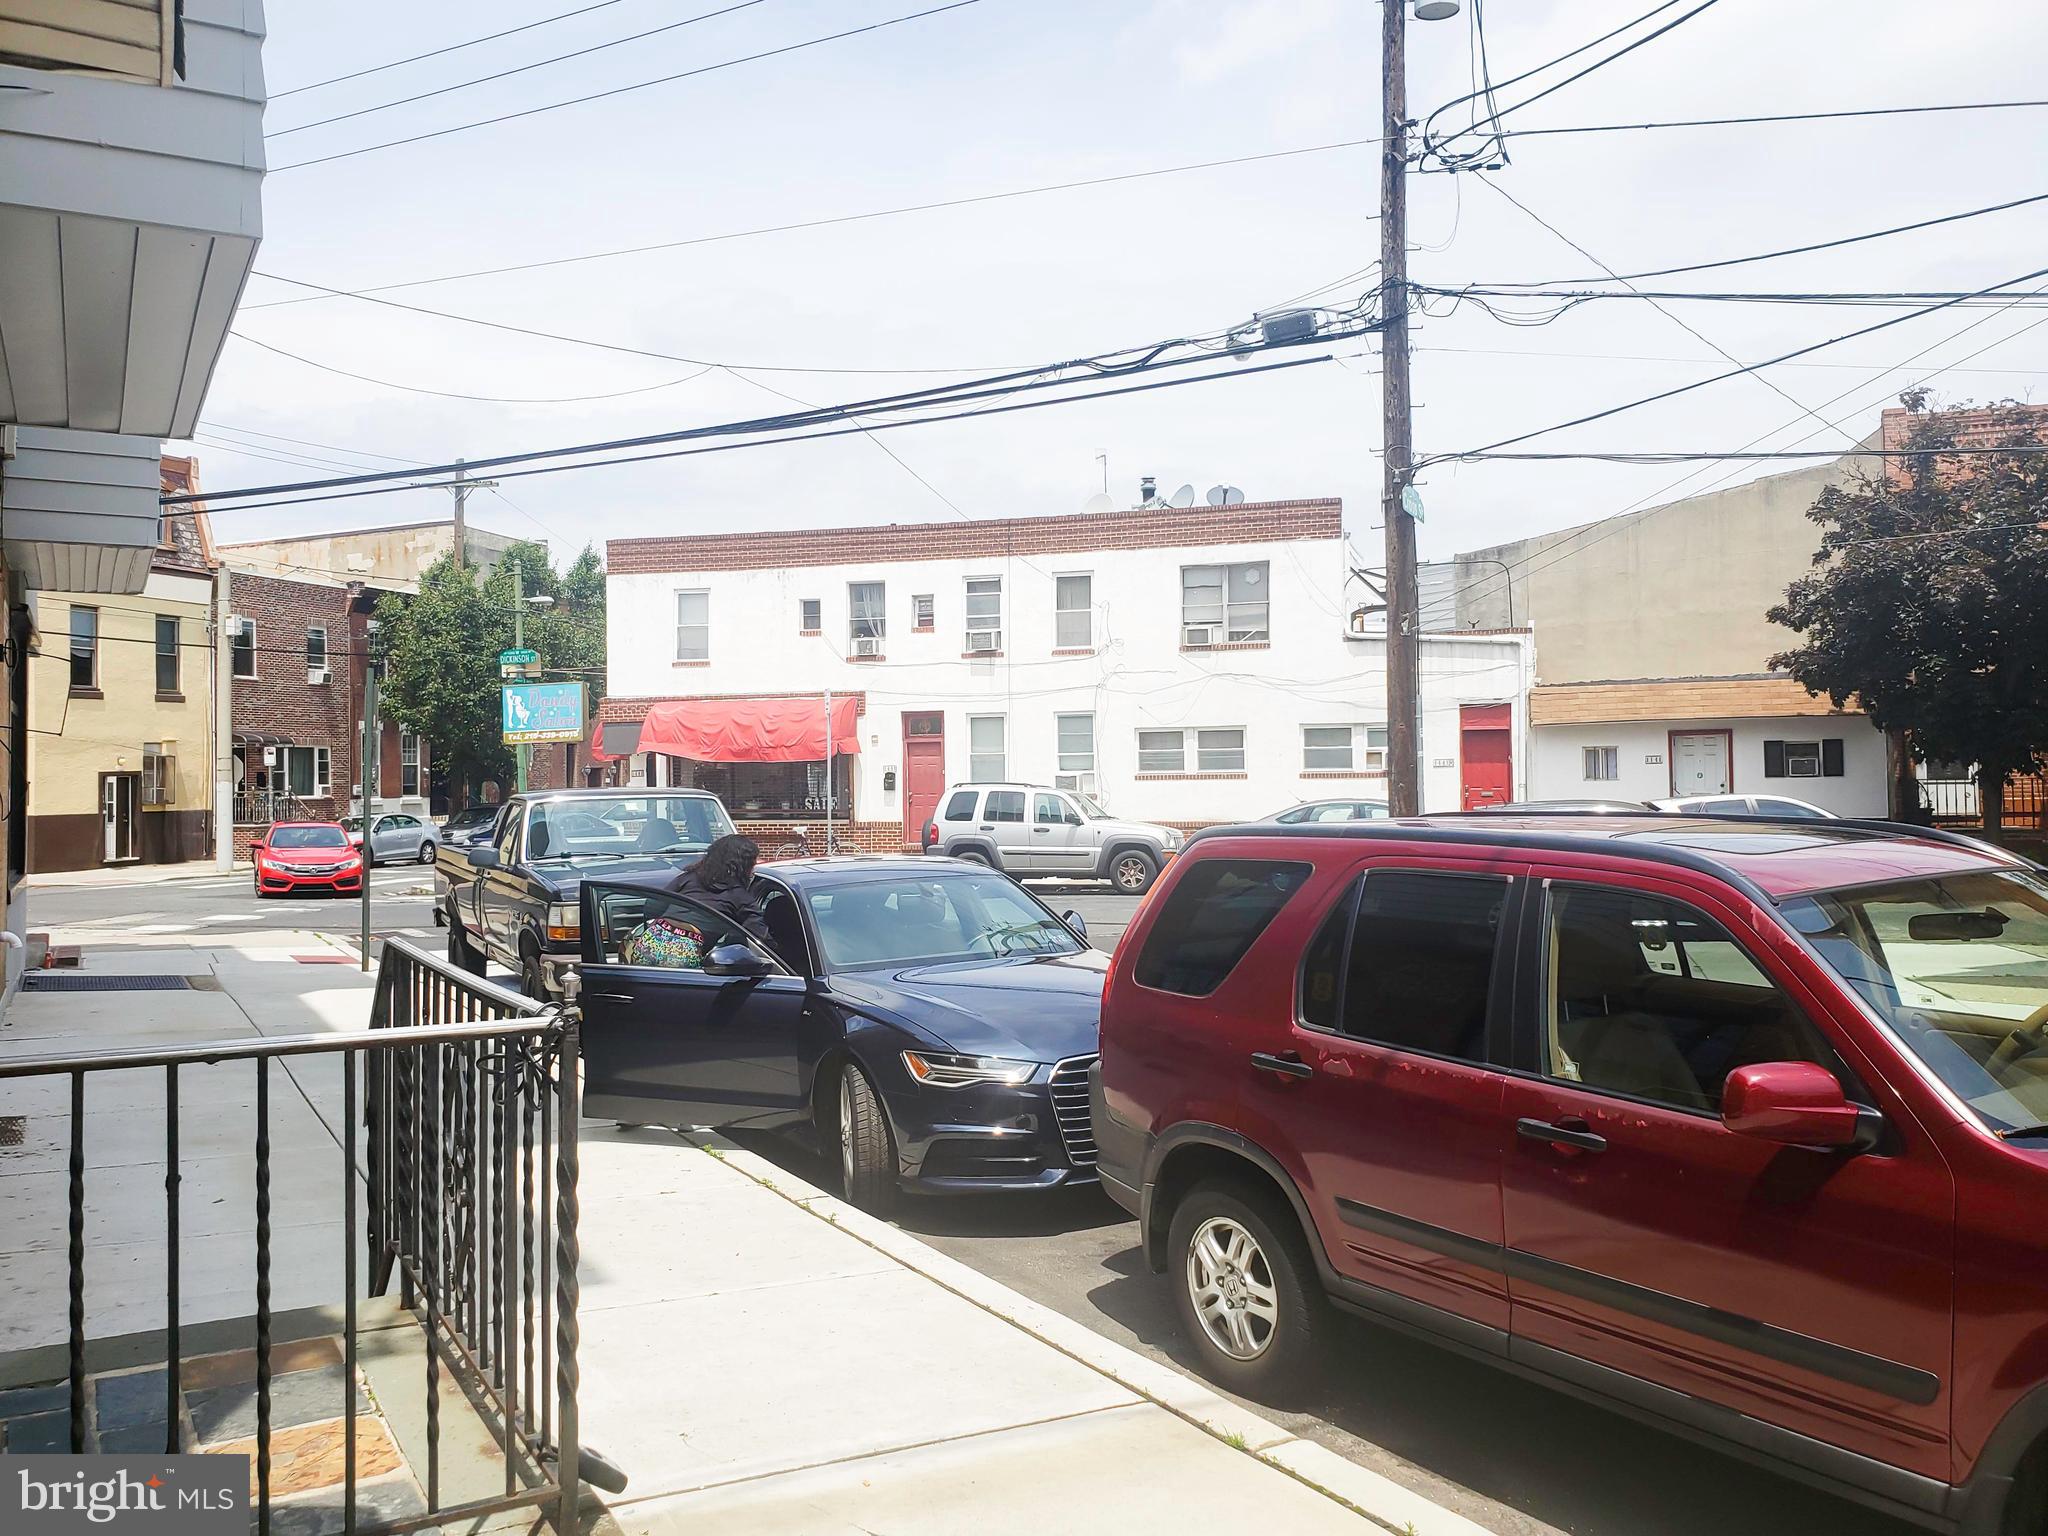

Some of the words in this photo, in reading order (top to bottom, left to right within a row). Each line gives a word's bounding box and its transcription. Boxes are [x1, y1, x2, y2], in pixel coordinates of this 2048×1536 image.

[500, 654, 530, 664] DICKINSON
[528, 688, 577, 711] Dandy
[531, 709, 577, 729] Salon
[673, 928, 686, 936] NO
